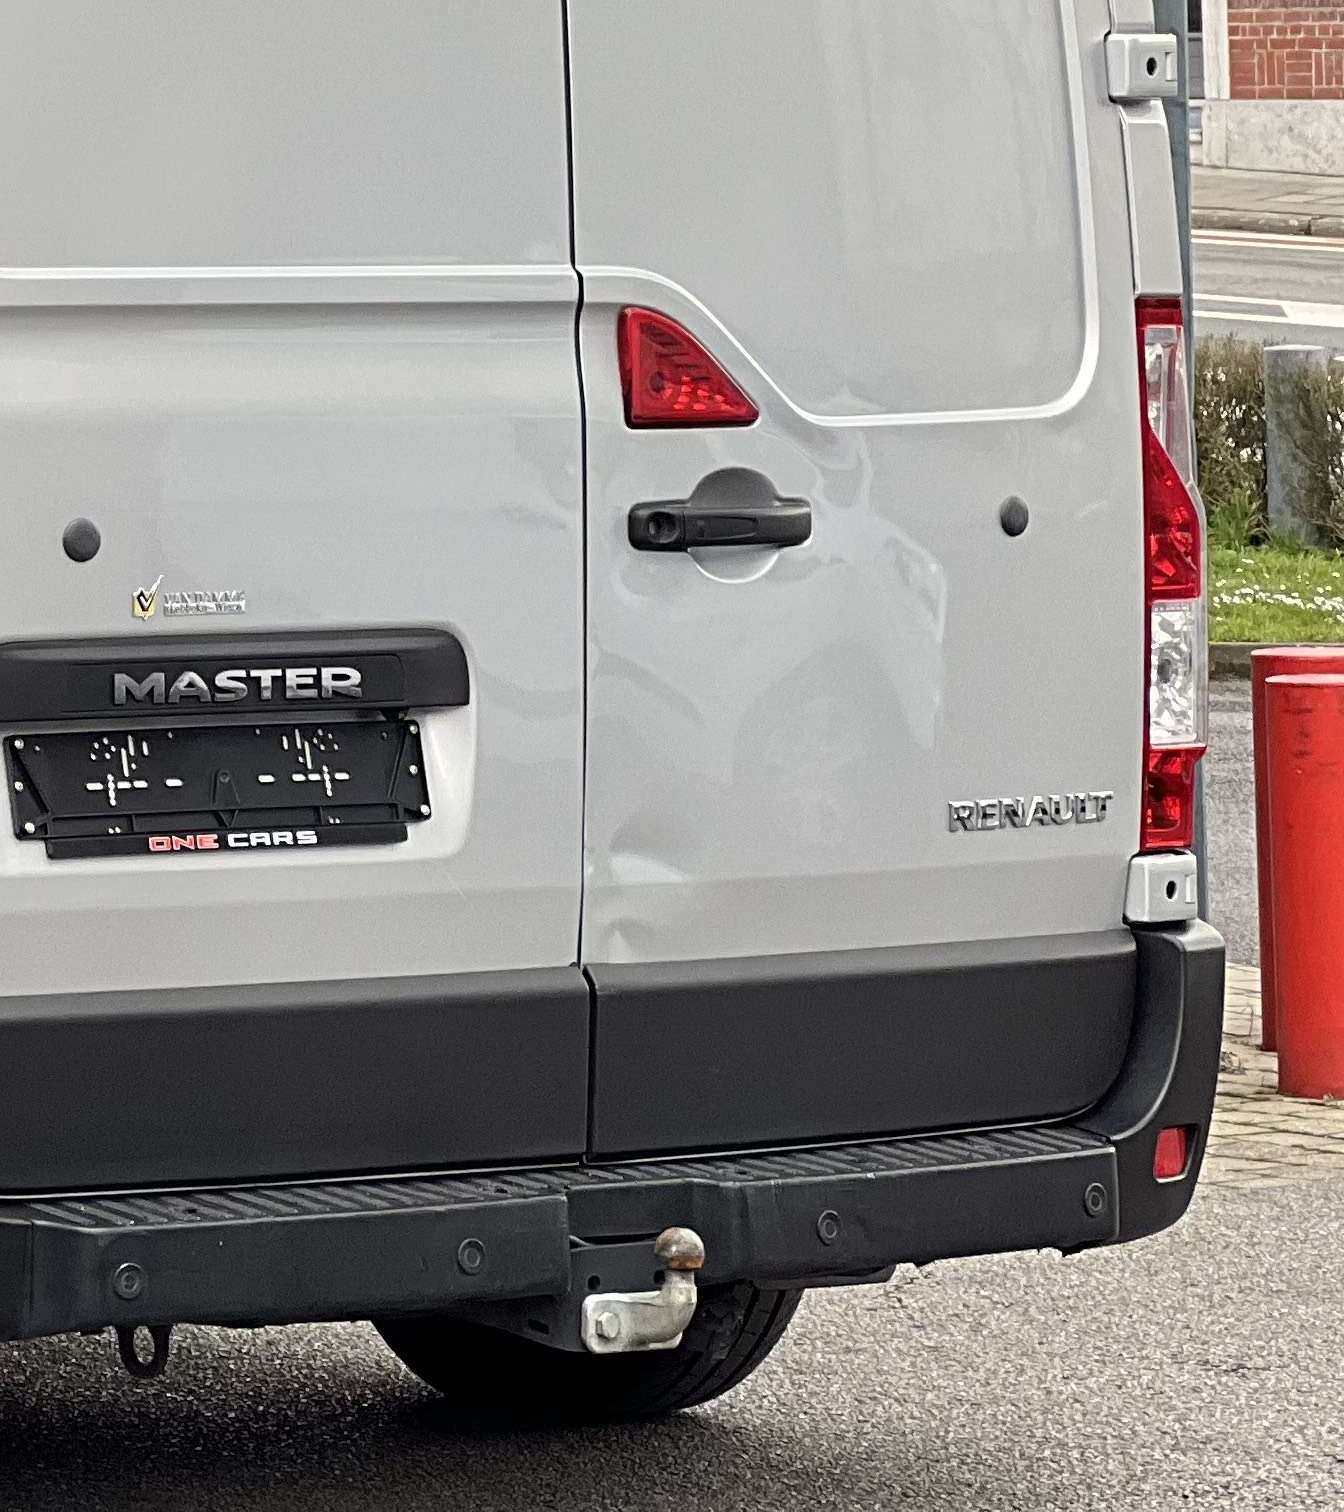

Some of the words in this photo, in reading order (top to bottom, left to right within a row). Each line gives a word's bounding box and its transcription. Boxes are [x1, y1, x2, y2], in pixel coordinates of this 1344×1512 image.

[113, 666, 363, 706] MASTER
[947, 790, 1115, 833] RENAULT
[148, 833, 220, 852] ONE
[227, 830, 319, 848] CARS
